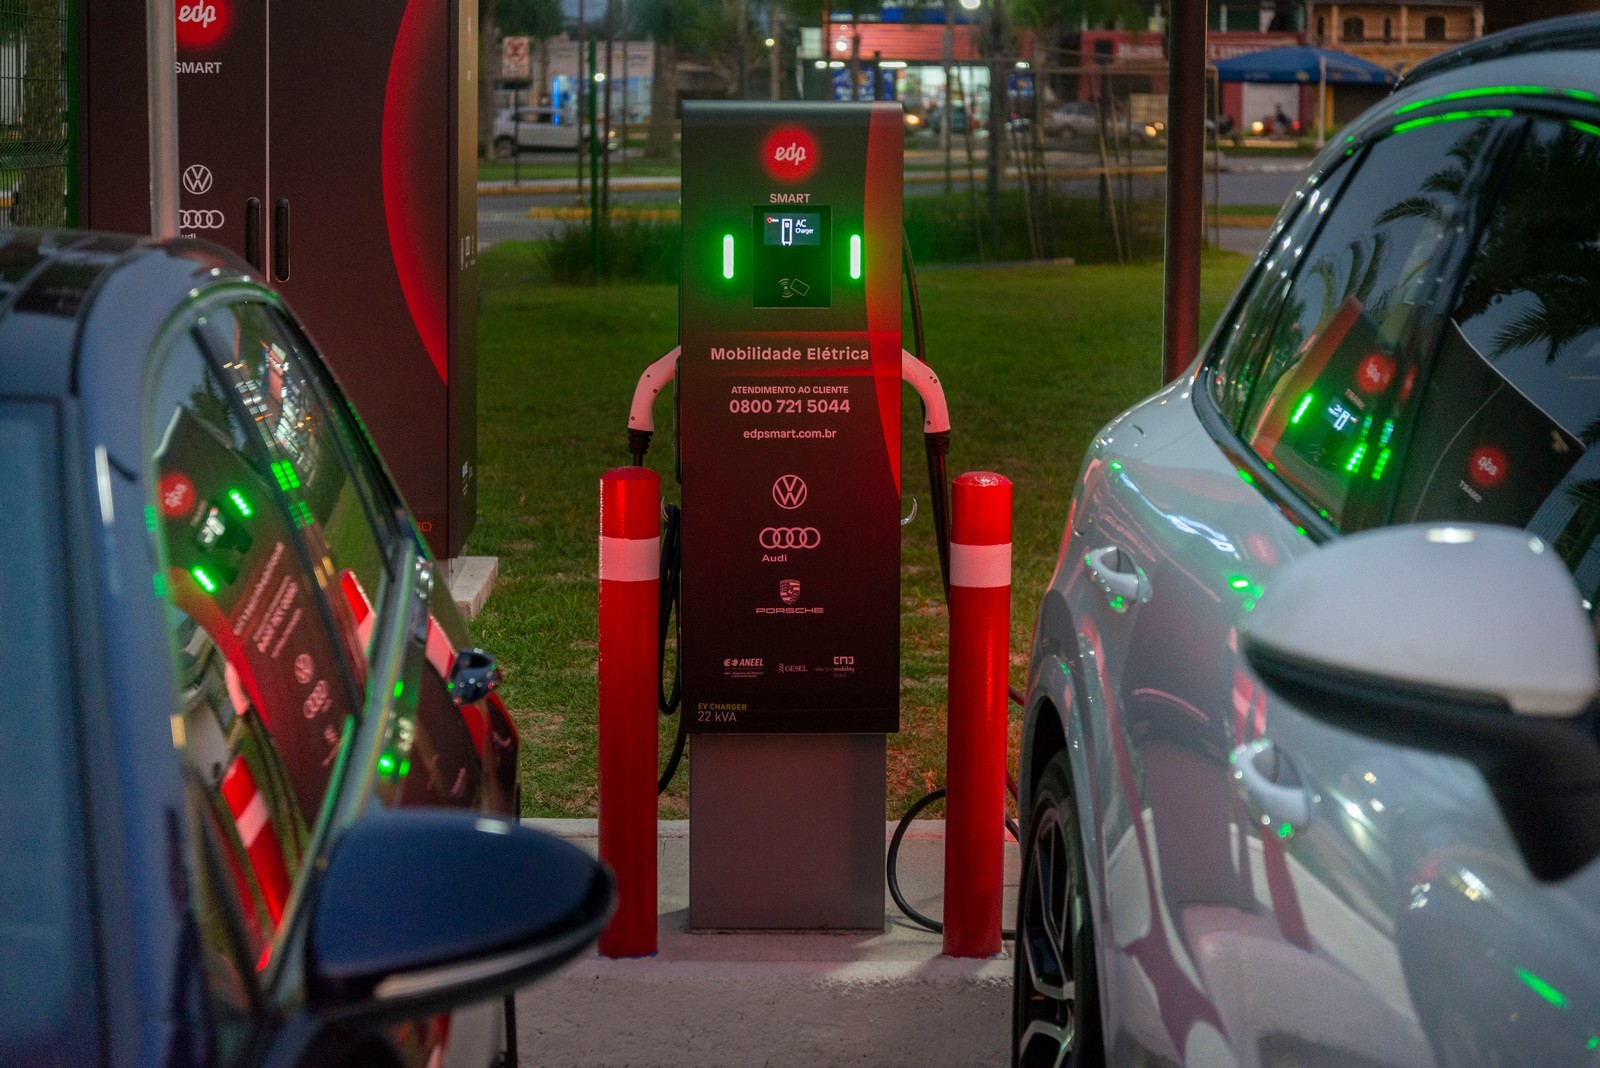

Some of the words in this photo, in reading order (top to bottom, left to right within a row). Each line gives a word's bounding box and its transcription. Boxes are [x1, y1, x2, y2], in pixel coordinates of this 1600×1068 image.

[177, 0, 217, 29] edp
[175, 61, 222, 74] SMART
[774, 142, 806, 165] edp
[769, 193, 811, 203] SMART
[795, 219, 807, 228] AC
[710, 346, 802, 361] Mobilidade
[807, 346, 869, 361] Elétrica
[731, 386, 796, 394] ATENDIMENTO
[798, 386, 811, 394] AO
[812, 386, 849, 394] CLIENTE
[729, 399, 772, 413] 0800
[776, 399, 802, 413] 721
[807, 399, 850, 413] 5044
[743, 429, 837, 440] edpsmart.com.br
[761, 554, 788, 562] Audi
[738, 658, 765, 667] ANEEL
[784, 664, 808, 672] GESEL
[698, 703, 708, 711] EV
[709, 703, 747, 711] CHARGER
[698, 711, 712, 722] 22
[715, 711, 737, 722] kVA
